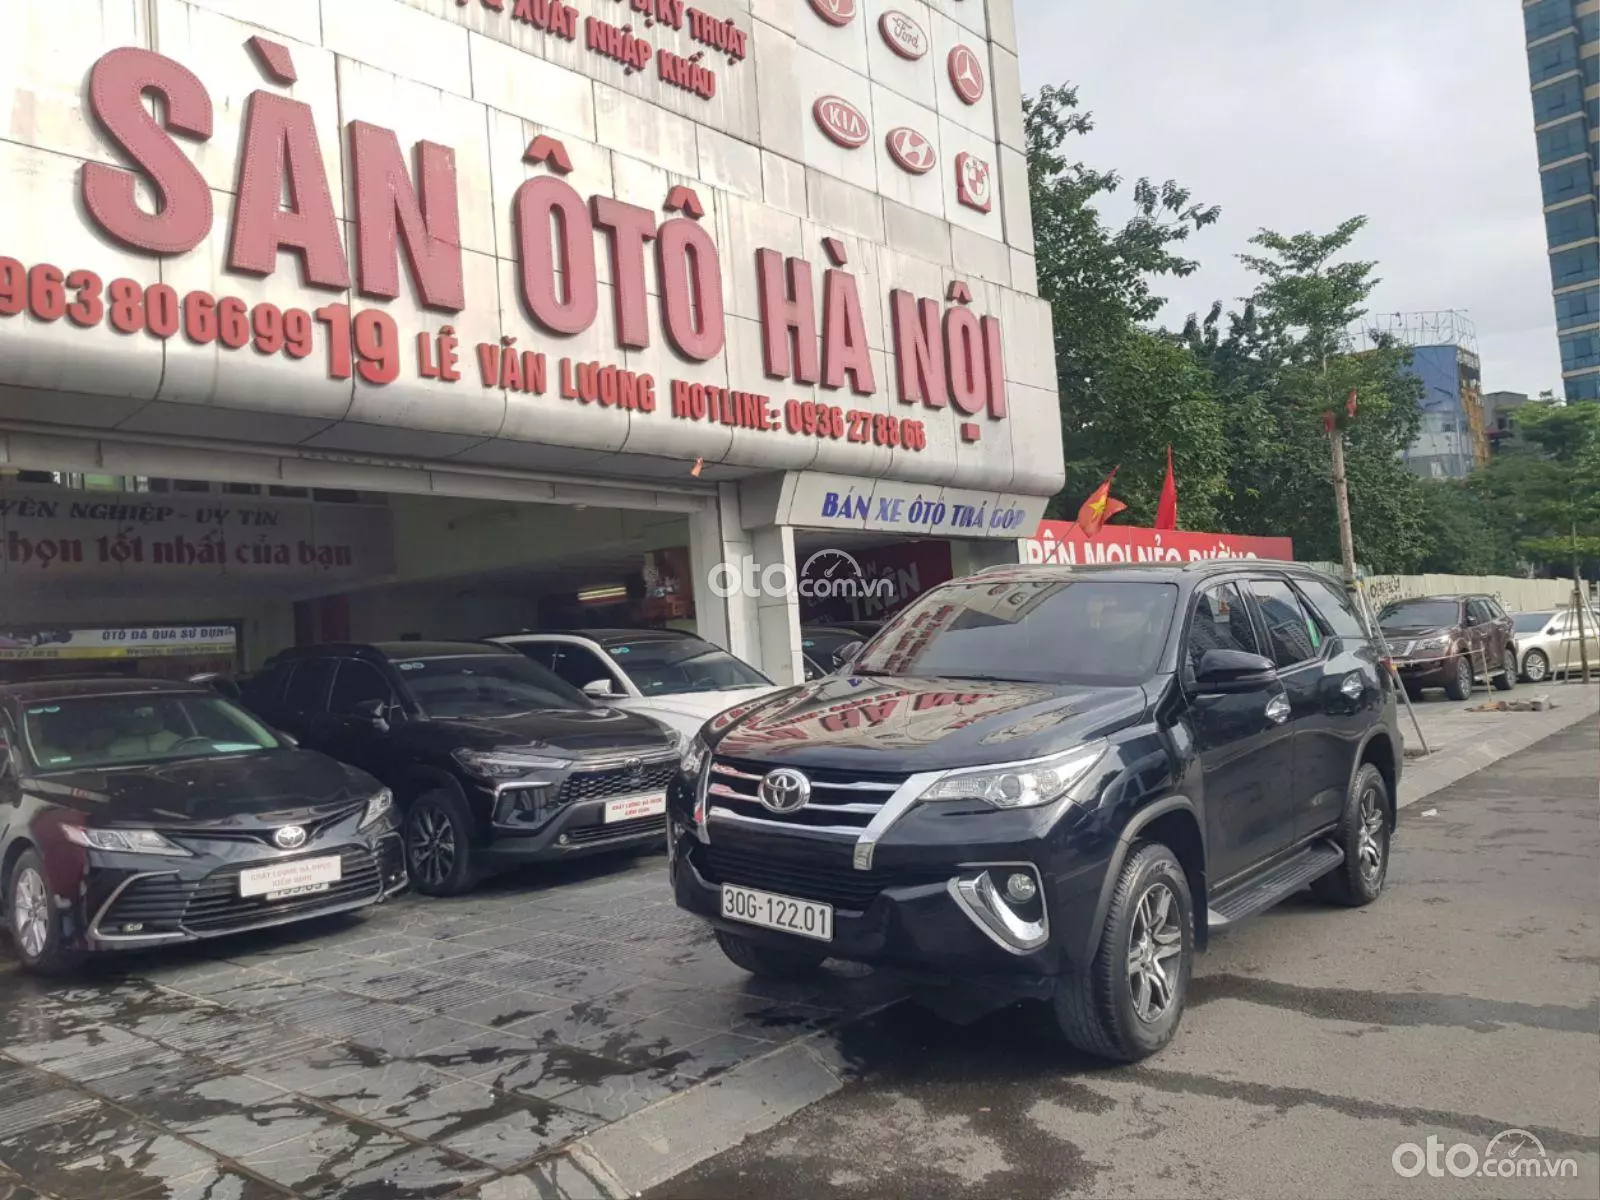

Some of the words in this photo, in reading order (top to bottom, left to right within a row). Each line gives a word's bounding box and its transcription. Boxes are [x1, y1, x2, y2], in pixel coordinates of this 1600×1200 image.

[585, 15, 653, 76] NHẬP
[686, 7, 748, 66] THUẬT
[892, 16, 920, 49] Ford
[829, 105, 862, 136] KIA
[81, 35, 465, 312] SÀN
[514, 135, 725, 362] ÔTÔ
[756, 236, 876, 395] HÀ
[890, 280, 1007, 441] NỘI
[314, 302, 401, 385] 19
[417, 325, 461, 381] LÊ
[477, 335, 547, 394] VĂN
[561, 358, 656, 413] LƯƠNG
[671, 379, 782, 431] HOTLINE:
[70, 501, 175, 526] NGHIỆP
[821, 485, 872, 520] BÁN
[875, 497, 905, 523] XE
[951, 500, 988, 529] TRẢ
[990, 501, 1027, 530] GÓP
[96, 526, 144, 563] tốt
[151, 528, 227, 566] nhất
[235, 533, 291, 565] của
[297, 539, 355, 571] bạn
[725, 888, 827, 935] 30G-122.01
